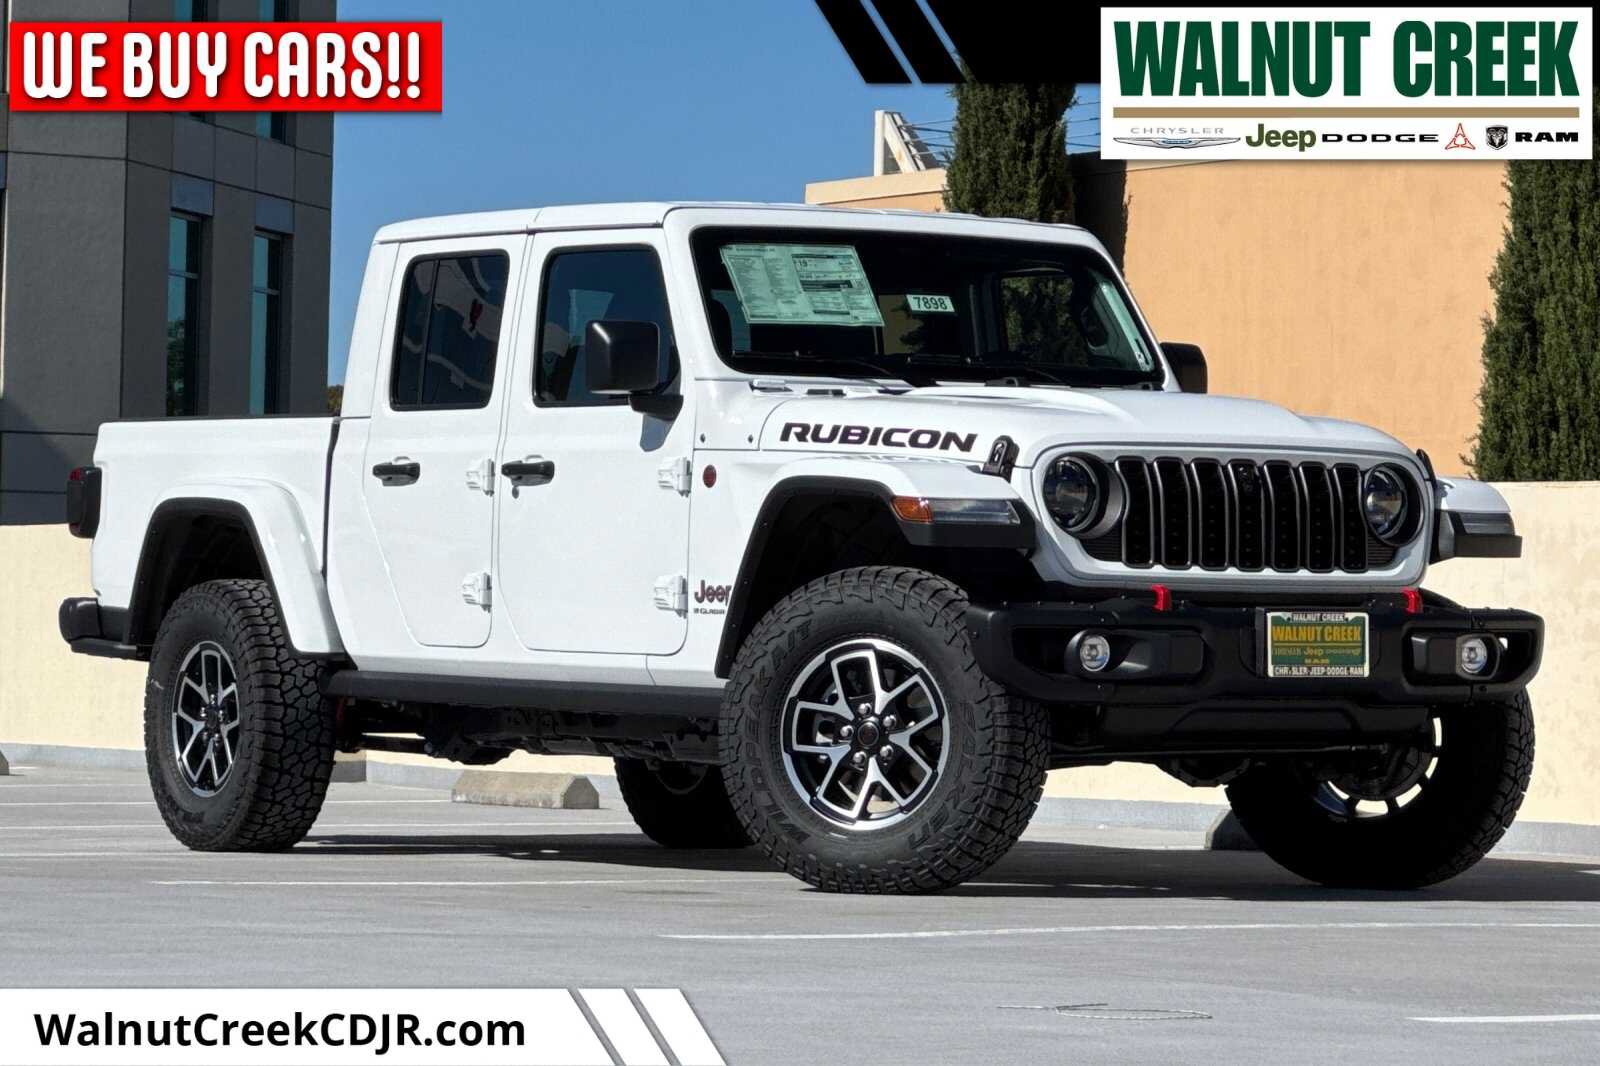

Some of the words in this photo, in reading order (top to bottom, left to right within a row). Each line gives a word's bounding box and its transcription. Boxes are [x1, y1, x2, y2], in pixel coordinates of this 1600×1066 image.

[913, 296, 947, 310] 7898
[779, 422, 978, 452] RUBICON
[1293, 613, 1320, 621] WALNUT
[1322, 613, 1345, 621] CREEK
[1272, 625, 1322, 641] WALNUT
[1324, 625, 1361, 641] CREEK
